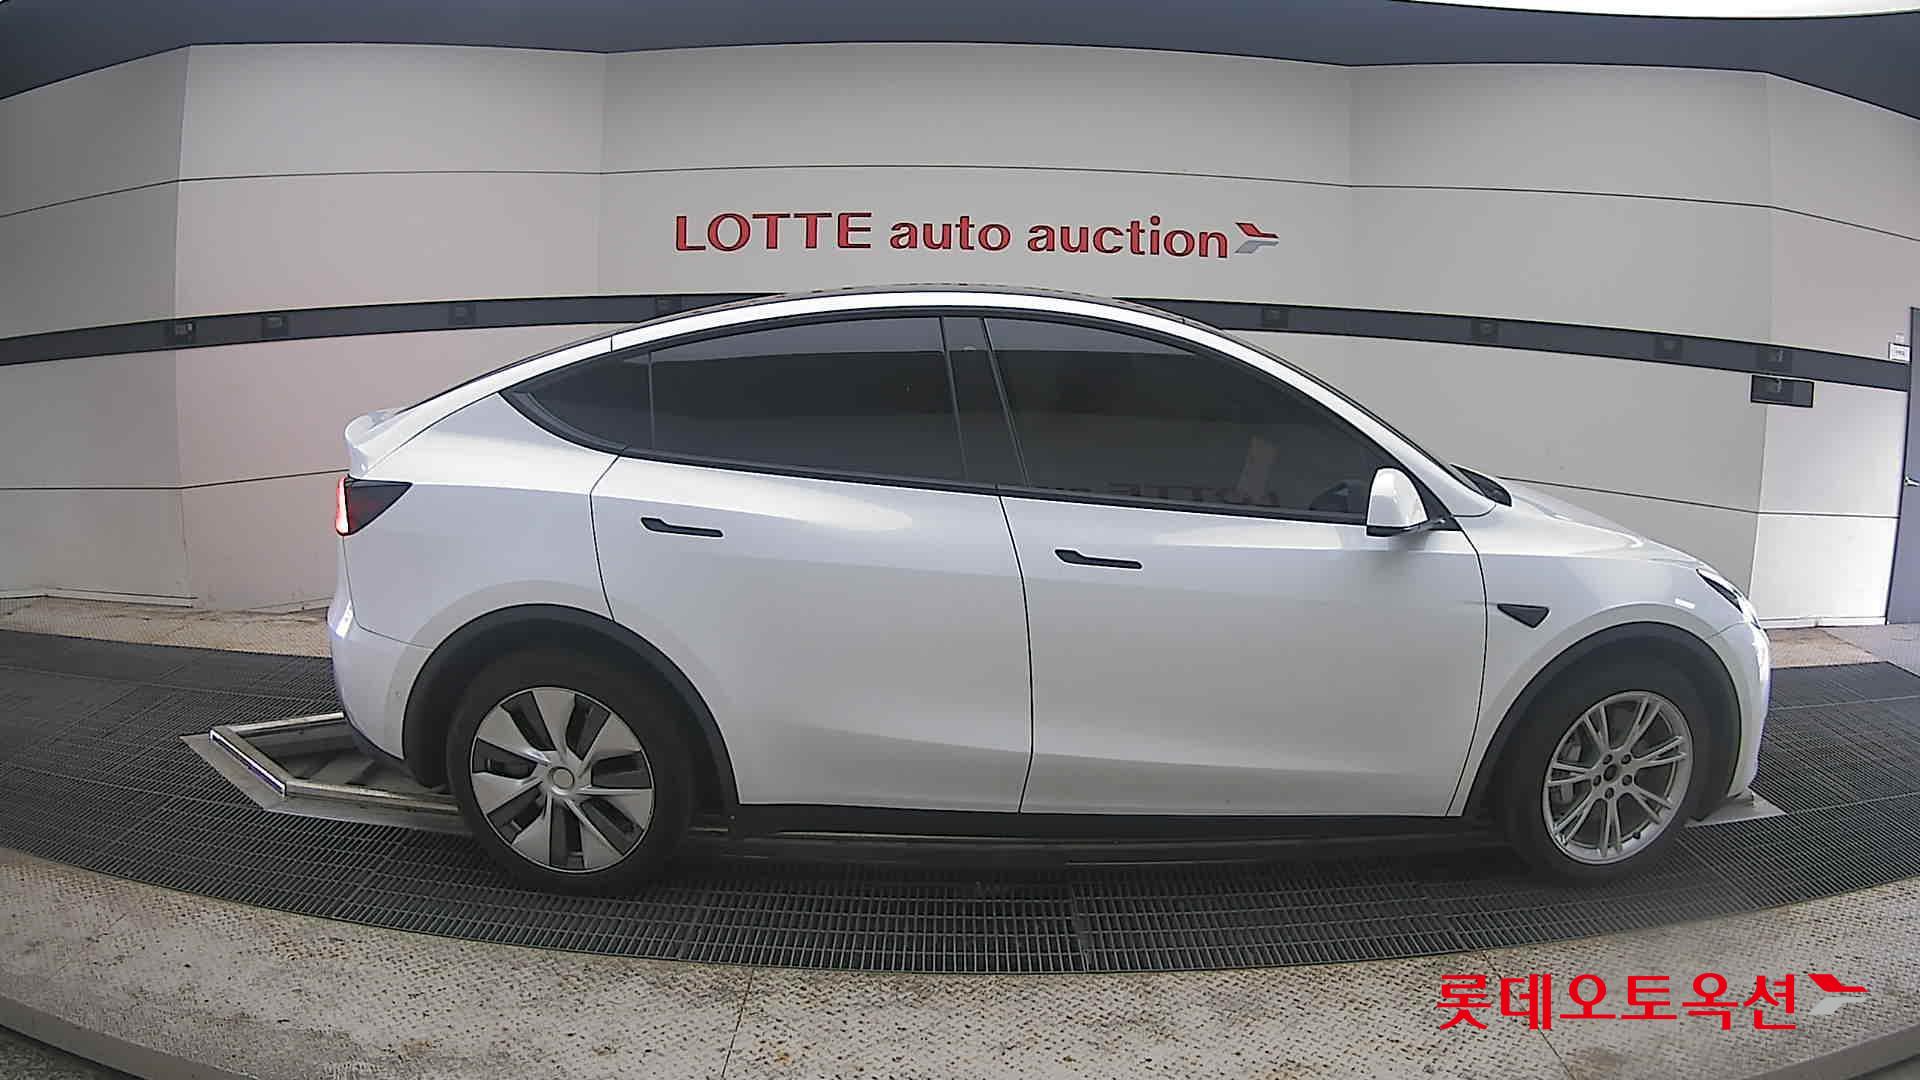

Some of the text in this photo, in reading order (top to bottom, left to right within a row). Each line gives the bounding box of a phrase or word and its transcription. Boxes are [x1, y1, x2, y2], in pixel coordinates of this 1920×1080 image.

[676, 213, 1229, 258] LOTTE auto auction
